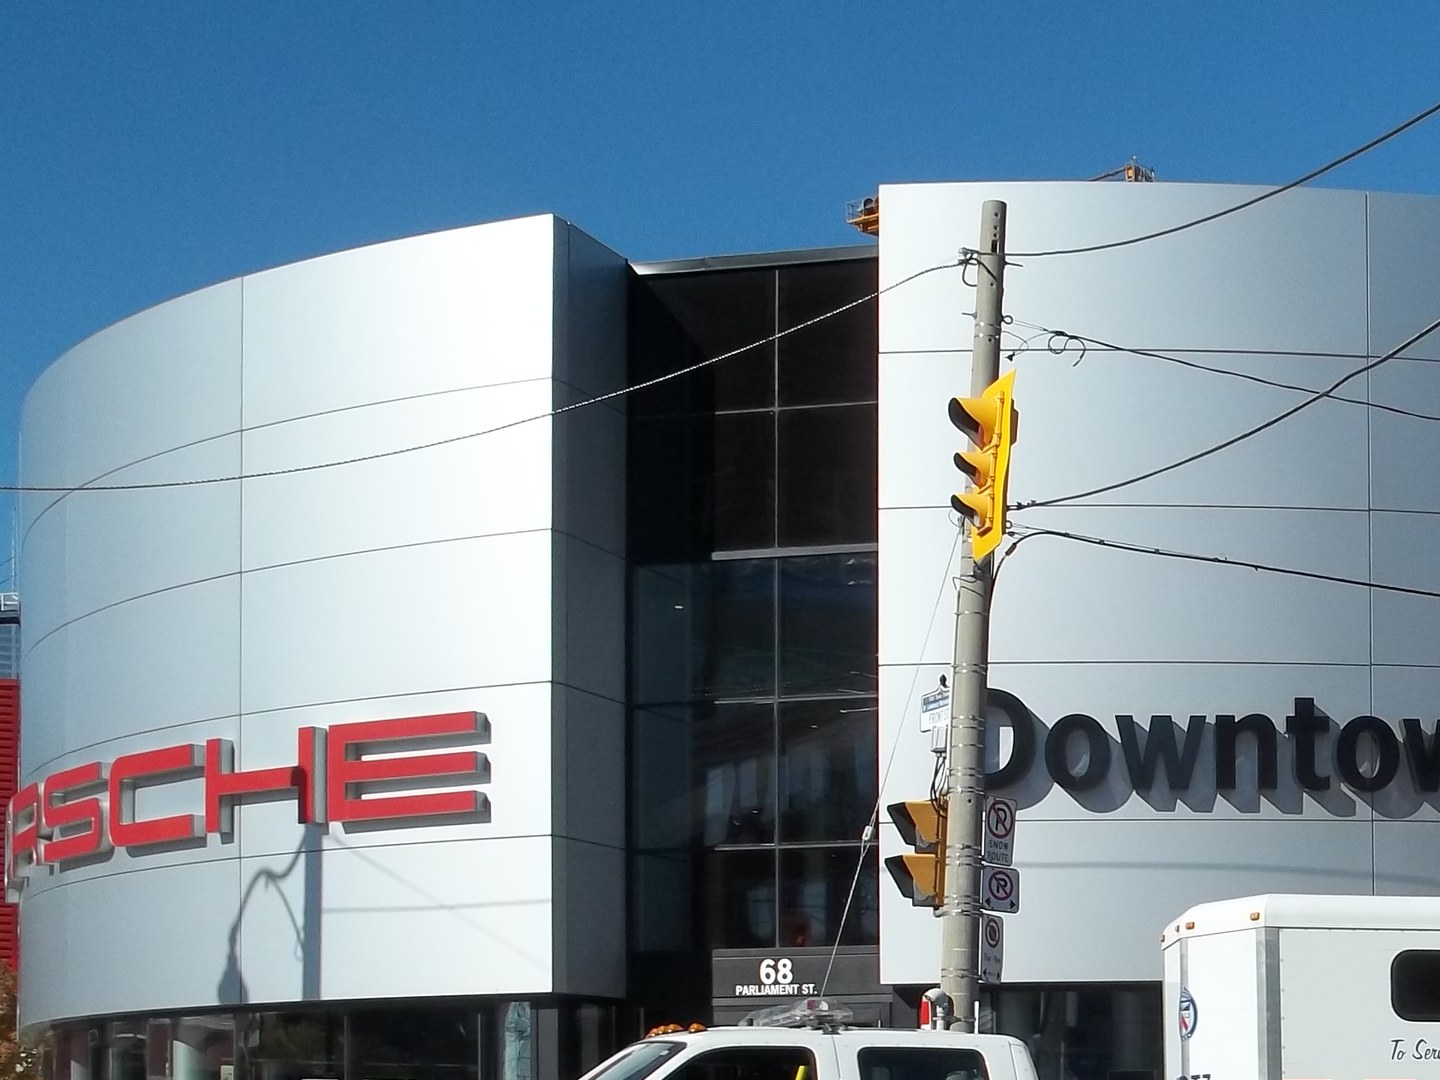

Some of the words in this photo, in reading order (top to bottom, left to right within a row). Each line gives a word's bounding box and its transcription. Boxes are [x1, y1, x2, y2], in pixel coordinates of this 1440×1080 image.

[988, 840, 1009, 850] SNOW
[987, 851, 1009, 862] ROUTE
[759, 958, 793, 985] 68
[735, 984, 800, 996] PARLIAMENT
[801, 983, 818, 995] ST.
[1390, 1039, 1407, 1061] To
